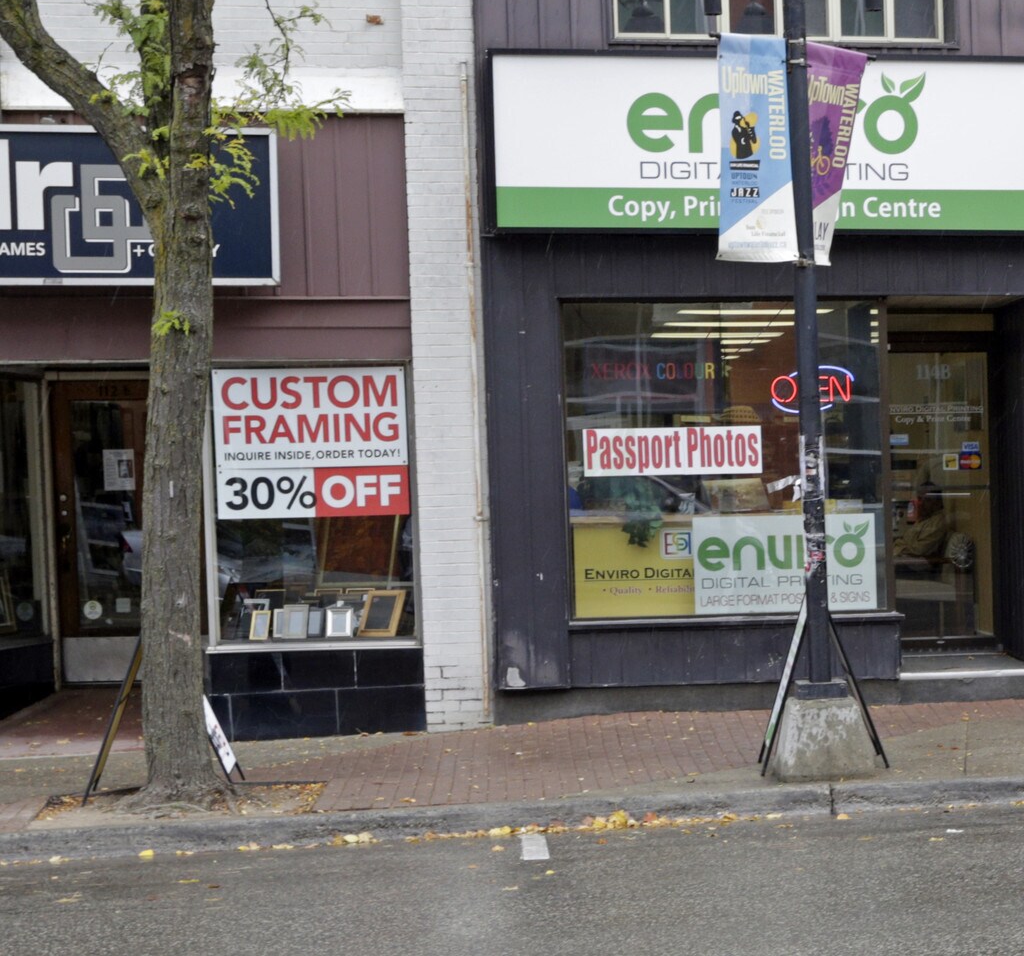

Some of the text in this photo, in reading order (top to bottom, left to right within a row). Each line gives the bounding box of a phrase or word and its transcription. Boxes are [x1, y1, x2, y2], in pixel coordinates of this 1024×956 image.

[721, 65, 768, 98] UpTown
[768, 69, 787, 160] WATERLOO
[832, 83, 860, 169] WATERLOO
[640, 161, 721, 180] DIGIT
[731, 187, 759, 197] JAZZ
[608, 195, 676, 222] Copy,
[684, 195, 720, 217] Pri
[863, 196, 941, 218] Centre
[591, 362, 716, 380] XEROX COLOUR
[221, 375, 398, 410] CUSTOM
[770, 374, 852, 403] OEN
[889, 405, 914, 413] NVIRO
[222, 411, 400, 445] FRAMING
[224, 451, 271, 461] INQUIRE
[358, 448, 401, 458] TODAY!
[586, 427, 759, 473] Passport Photos
[225, 473, 401, 511] 30% OFF
[610, 586, 642, 596] Quality
[701, 576, 771, 590] DIGITAL
[700, 595, 735, 608] LARGE
[736, 594, 780, 606] FORMAT
[831, 592, 838, 603] &
[839, 591, 871, 603] SIGNS
